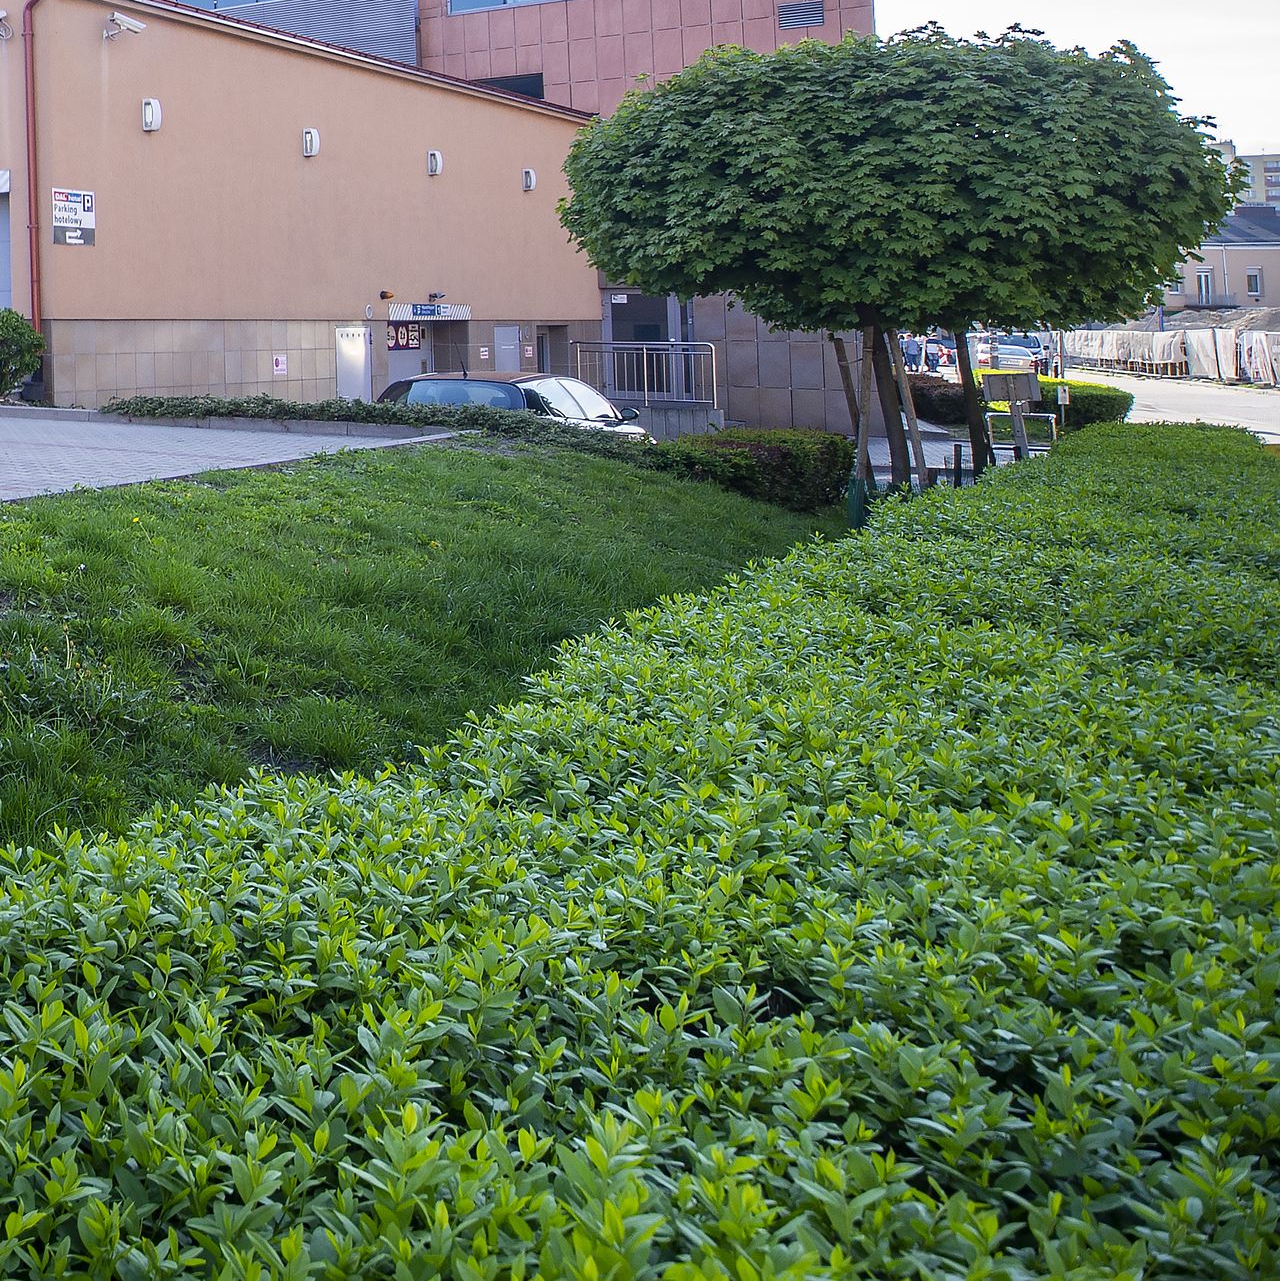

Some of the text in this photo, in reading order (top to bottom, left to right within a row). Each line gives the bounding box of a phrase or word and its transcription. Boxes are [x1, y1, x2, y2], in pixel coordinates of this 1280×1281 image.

[54, 203, 78, 215] Parking
[84, 195, 92, 211] P
[54, 214, 82, 226] hotelowy
